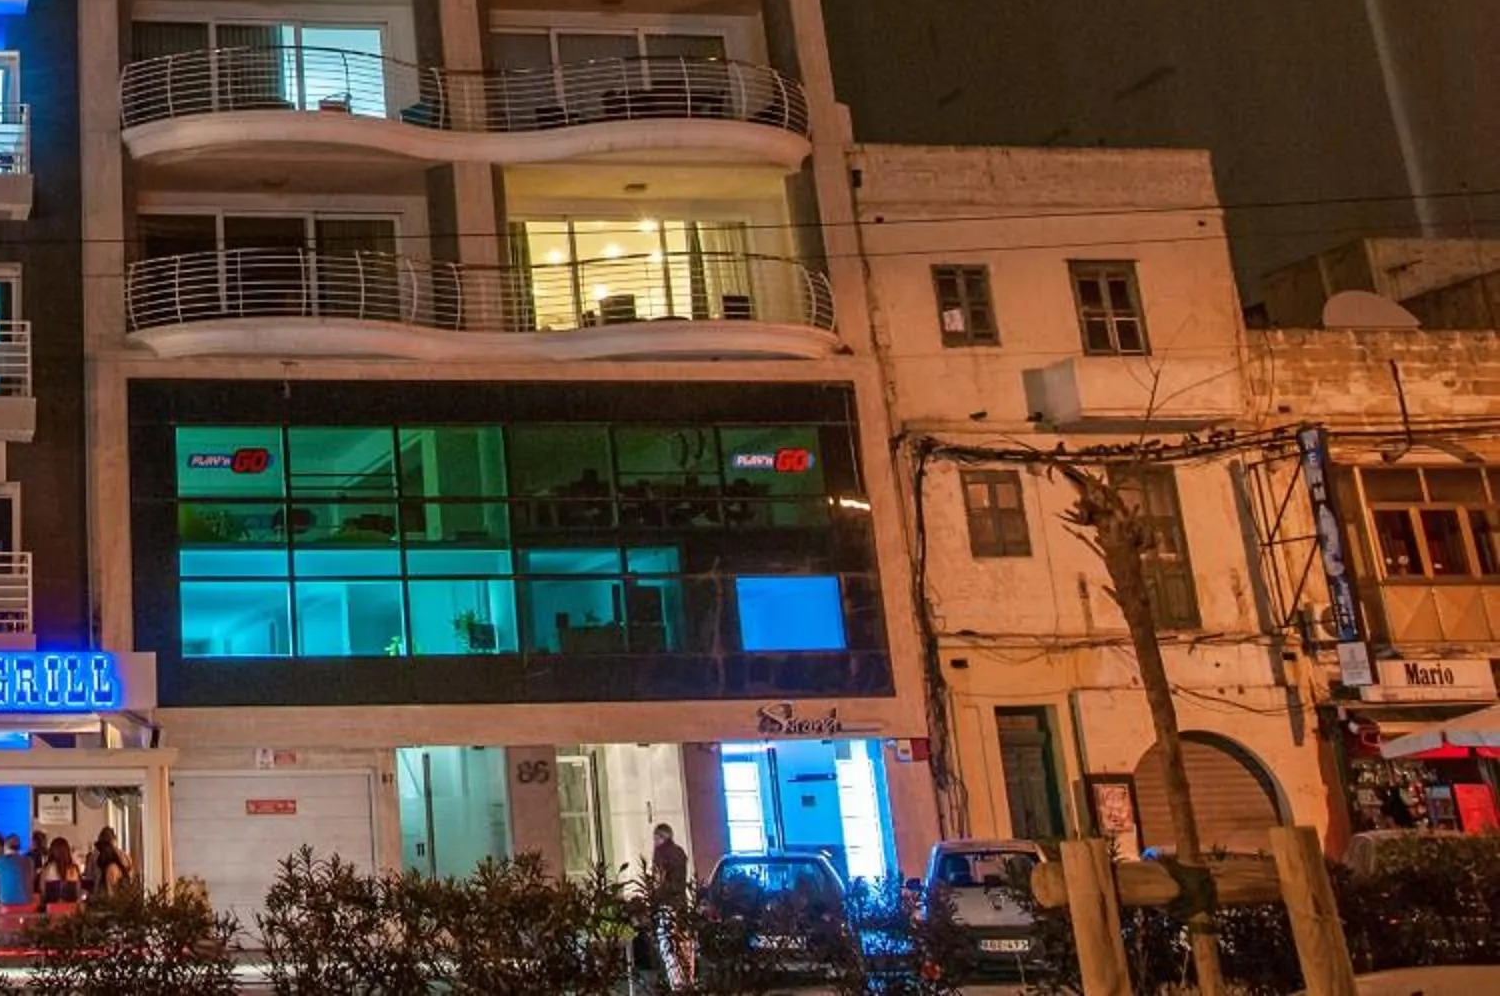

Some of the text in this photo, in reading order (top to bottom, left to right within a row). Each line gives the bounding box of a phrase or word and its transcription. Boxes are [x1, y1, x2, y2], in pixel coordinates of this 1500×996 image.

[232, 448, 269, 473] GO
[775, 448, 809, 472] GO
[1404, 661, 1455, 685] Mario
[516, 760, 550, 784] 86
